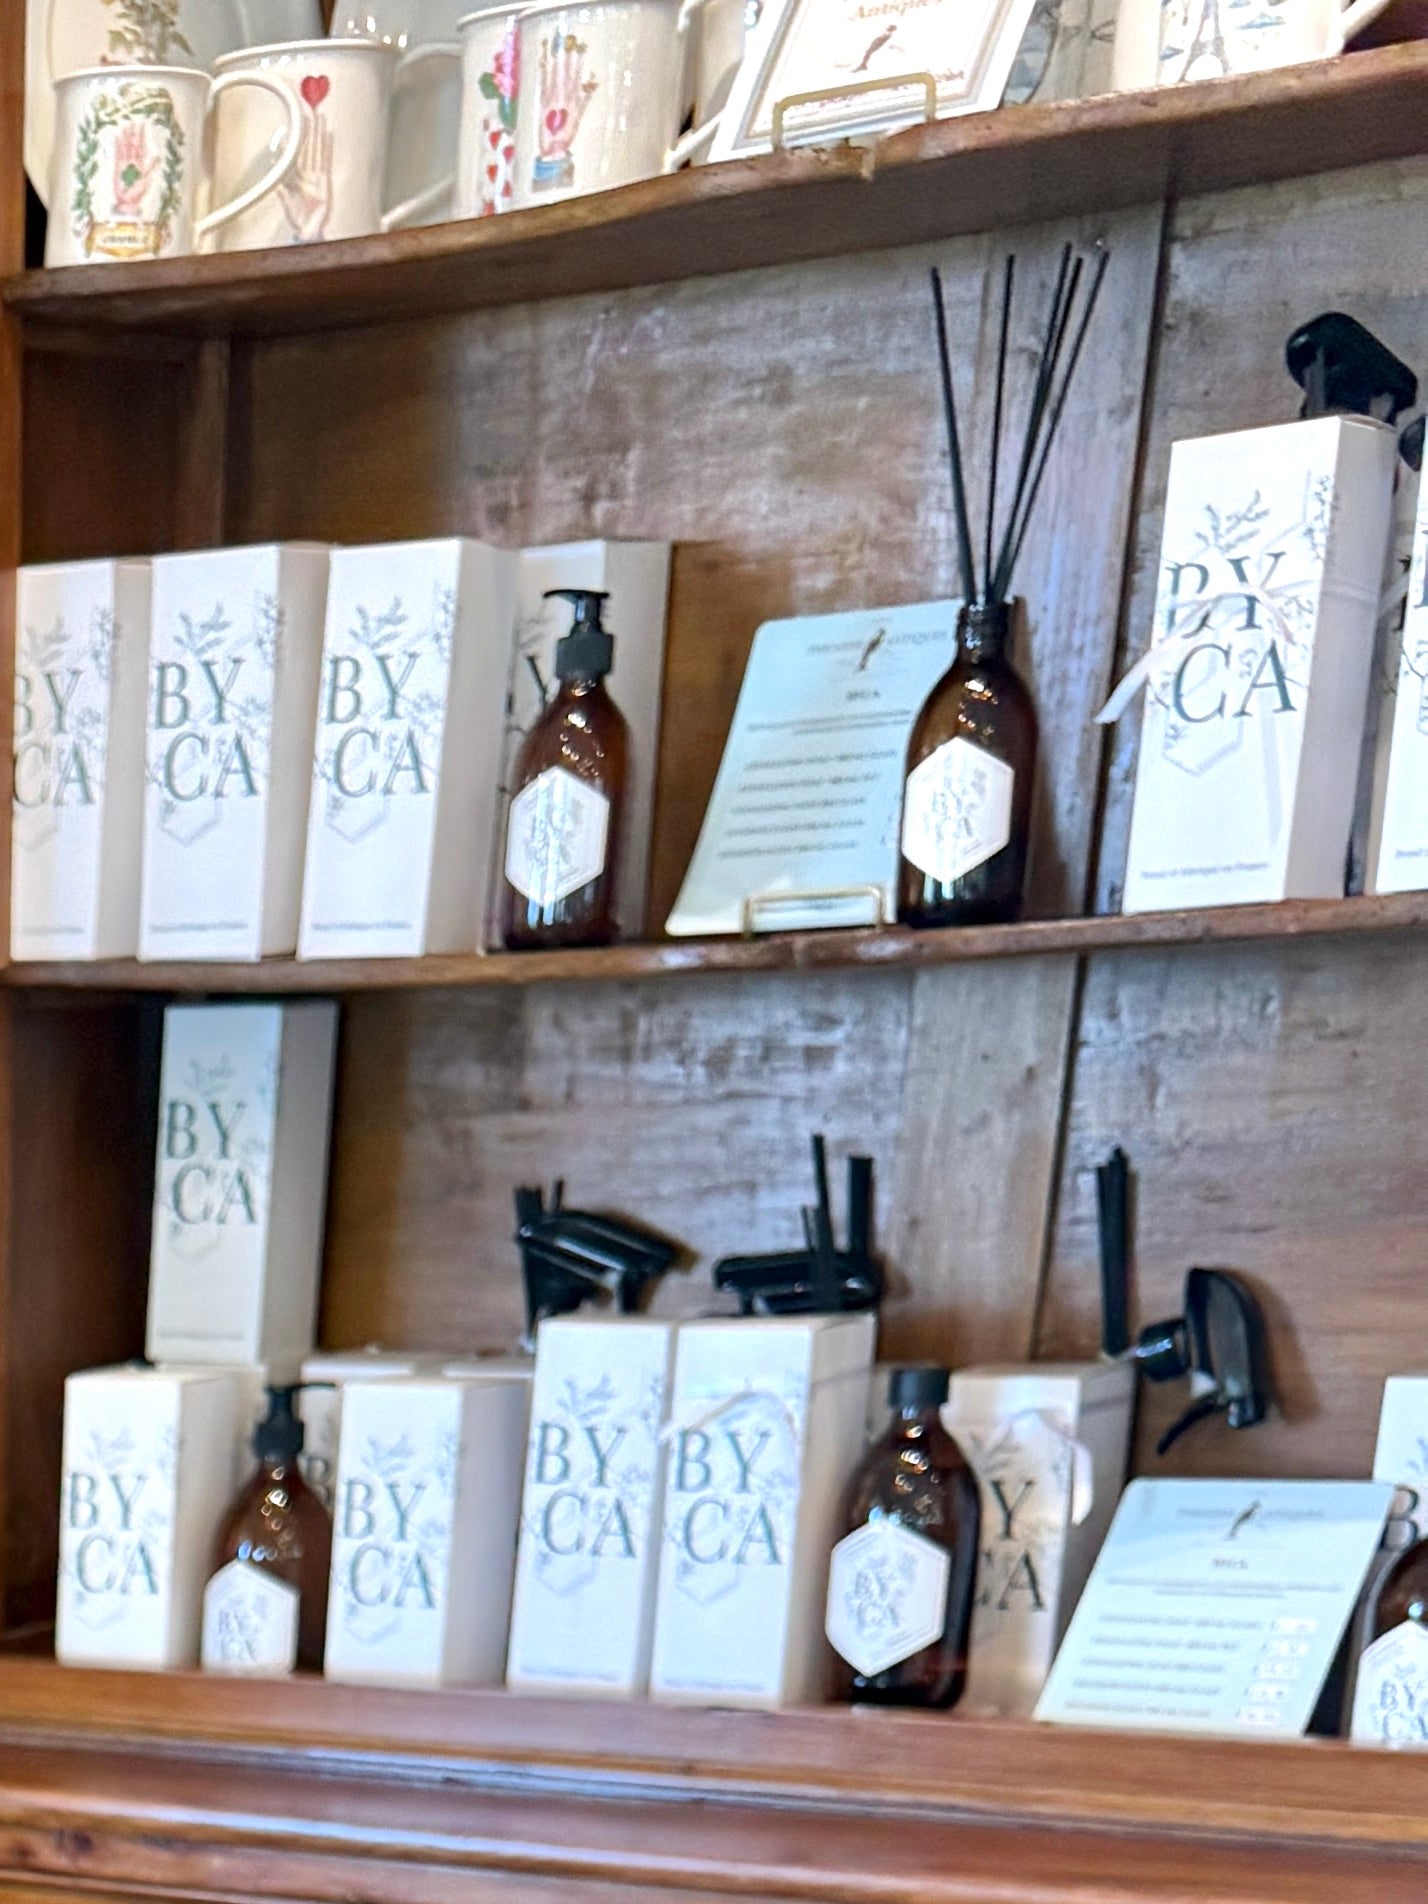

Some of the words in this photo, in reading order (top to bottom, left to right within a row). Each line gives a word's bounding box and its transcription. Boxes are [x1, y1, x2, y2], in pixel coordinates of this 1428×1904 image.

[153, 656, 245, 730] BY
[325, 652, 421, 725] BY
[1174, 639, 1297, 723] CA
[13, 739, 96, 807] CA
[163, 730, 259, 801] CA
[333, 726, 431, 798] CA
[166, 1100, 247, 1159] BY
[171, 1162, 258, 1226] CA
[534, 1421, 627, 1487] BY
[674, 1429, 772, 1493] BY
[70, 1472, 145, 1531] BY
[344, 1479, 425, 1541] BY
[543, 1487, 637, 1558] CA
[683, 1496, 782, 1565] CA
[76, 1533, 159, 1595] CA
[350, 1543, 437, 1609] CA
